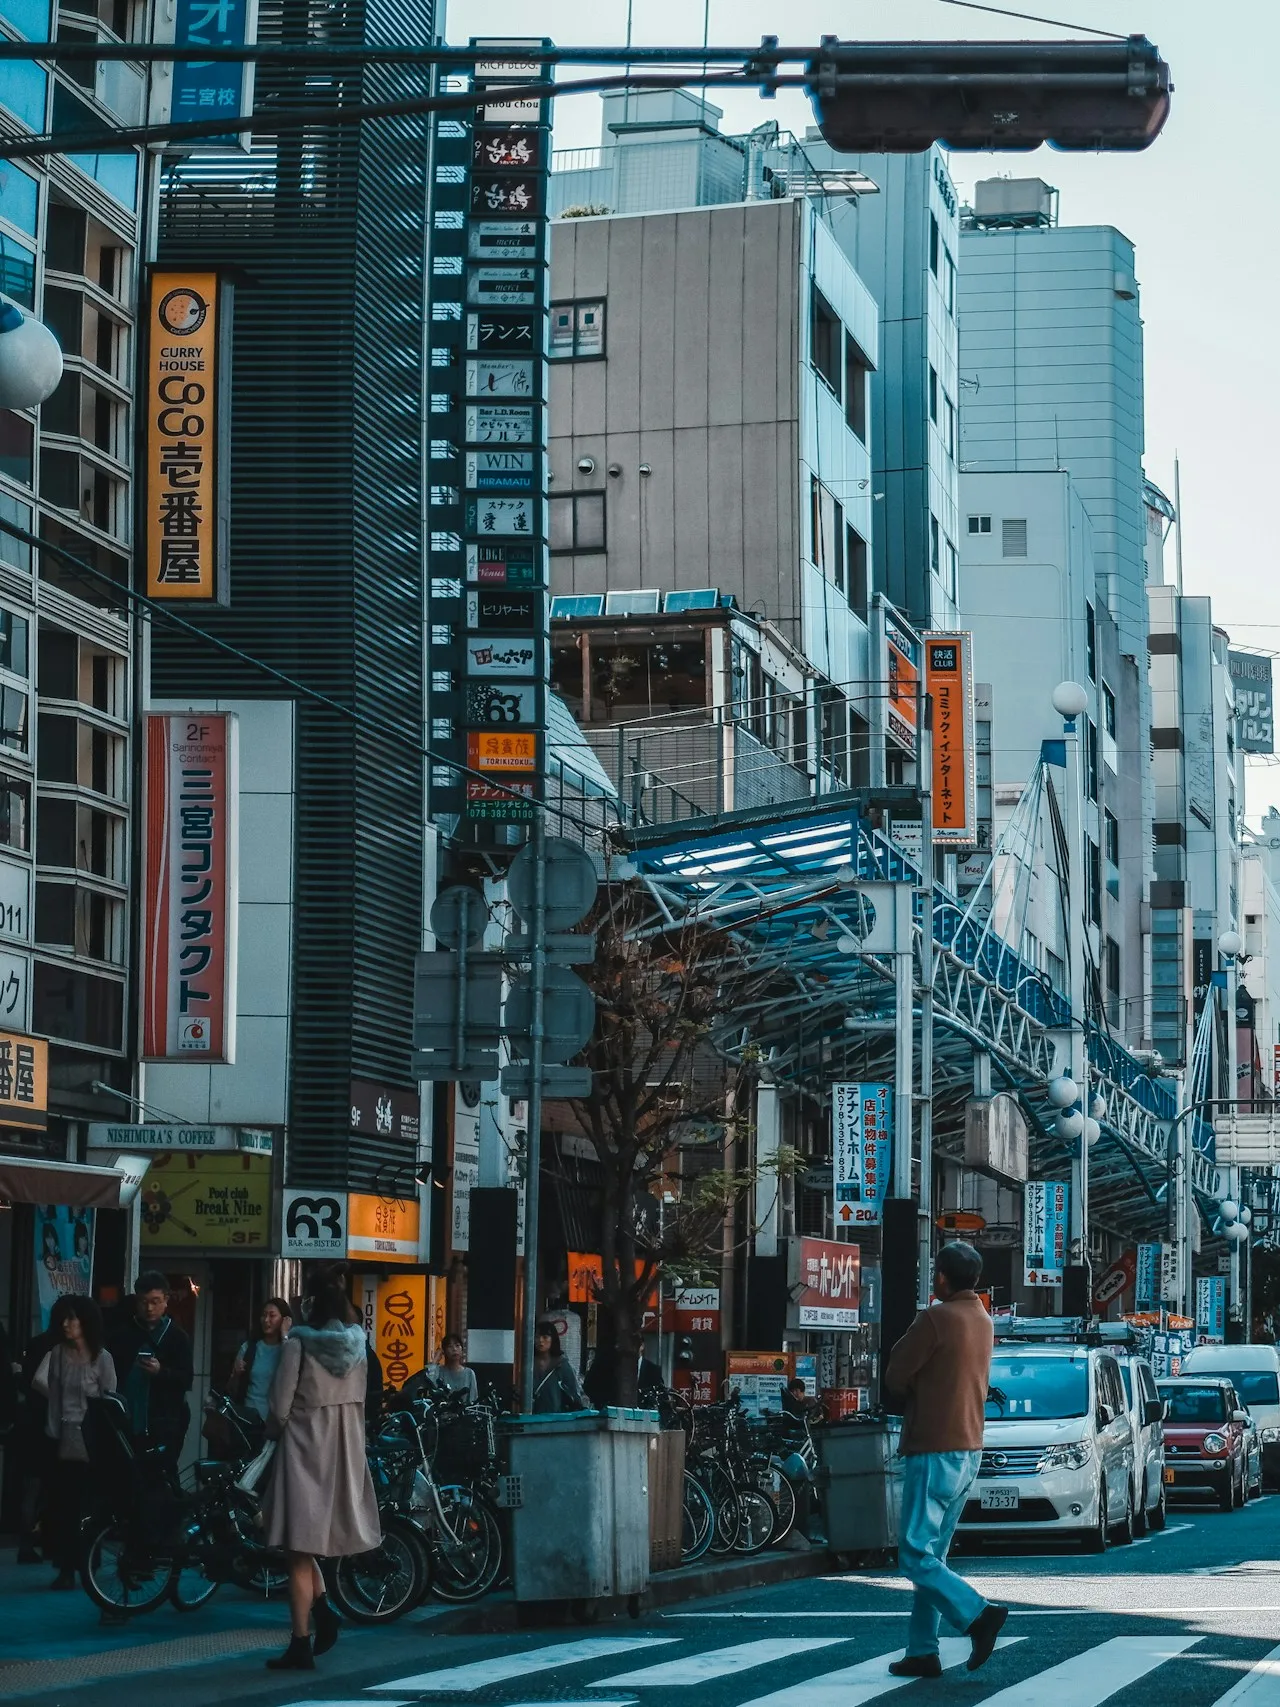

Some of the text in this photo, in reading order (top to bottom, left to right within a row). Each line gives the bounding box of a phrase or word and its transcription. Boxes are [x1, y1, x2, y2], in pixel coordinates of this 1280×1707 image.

[180, 88, 235, 106] 三宮校
[514, 100, 539, 108] chou
[469, 323, 477, 344] 7F
[480, 323, 532, 341] ランス
[160, 347, 204, 358] CURRY
[159, 360, 205, 372] HOUSE
[468, 369, 476, 390] 7F
[483, 431, 526, 442] ノルテ
[485, 454, 525, 469] WIN
[468, 462, 476, 481] 5F
[479, 477, 531, 486] HIRAMATU
[488, 501, 525, 510] スナック
[468, 601, 477, 621] 3F
[482, 604, 529, 616] ビリヤード
[933, 649, 953, 659] 快活
[487, 694, 521, 721] 63
[186, 723, 210, 741] 2F
[172, 743, 223, 755] Sannomiya
[938, 686, 953, 824] コミック・インターネット
[179, 754, 217, 764] Contact
[179, 769, 214, 1013] 三宮コンタクト
[351, 1105, 361, 1127] 9F
[877, 1087, 889, 1141] オーナー様
[107, 1128, 216, 1145] NISHIMURA'S COFFEE
[846, 1087, 860, 1181] テナントホーム
[863, 1099, 877, 1200] 店舗物件募集中
[208, 1187, 249, 1199] Pool club
[195, 1199, 262, 1216] Break Nine
[286, 1196, 342, 1239] 63
[1034, 1185, 1044, 1253] テナントホーム
[231, 1231, 262, 1244] 3F
[288, 1239, 303, 1247] BAR
[313, 1239, 341, 1248] BISTRO
[1143, 1246, 1152, 1300] テナントホーム
[691, 1317, 713, 1331] 賃貸
[988, 1496, 1016, 1508] 73-37
